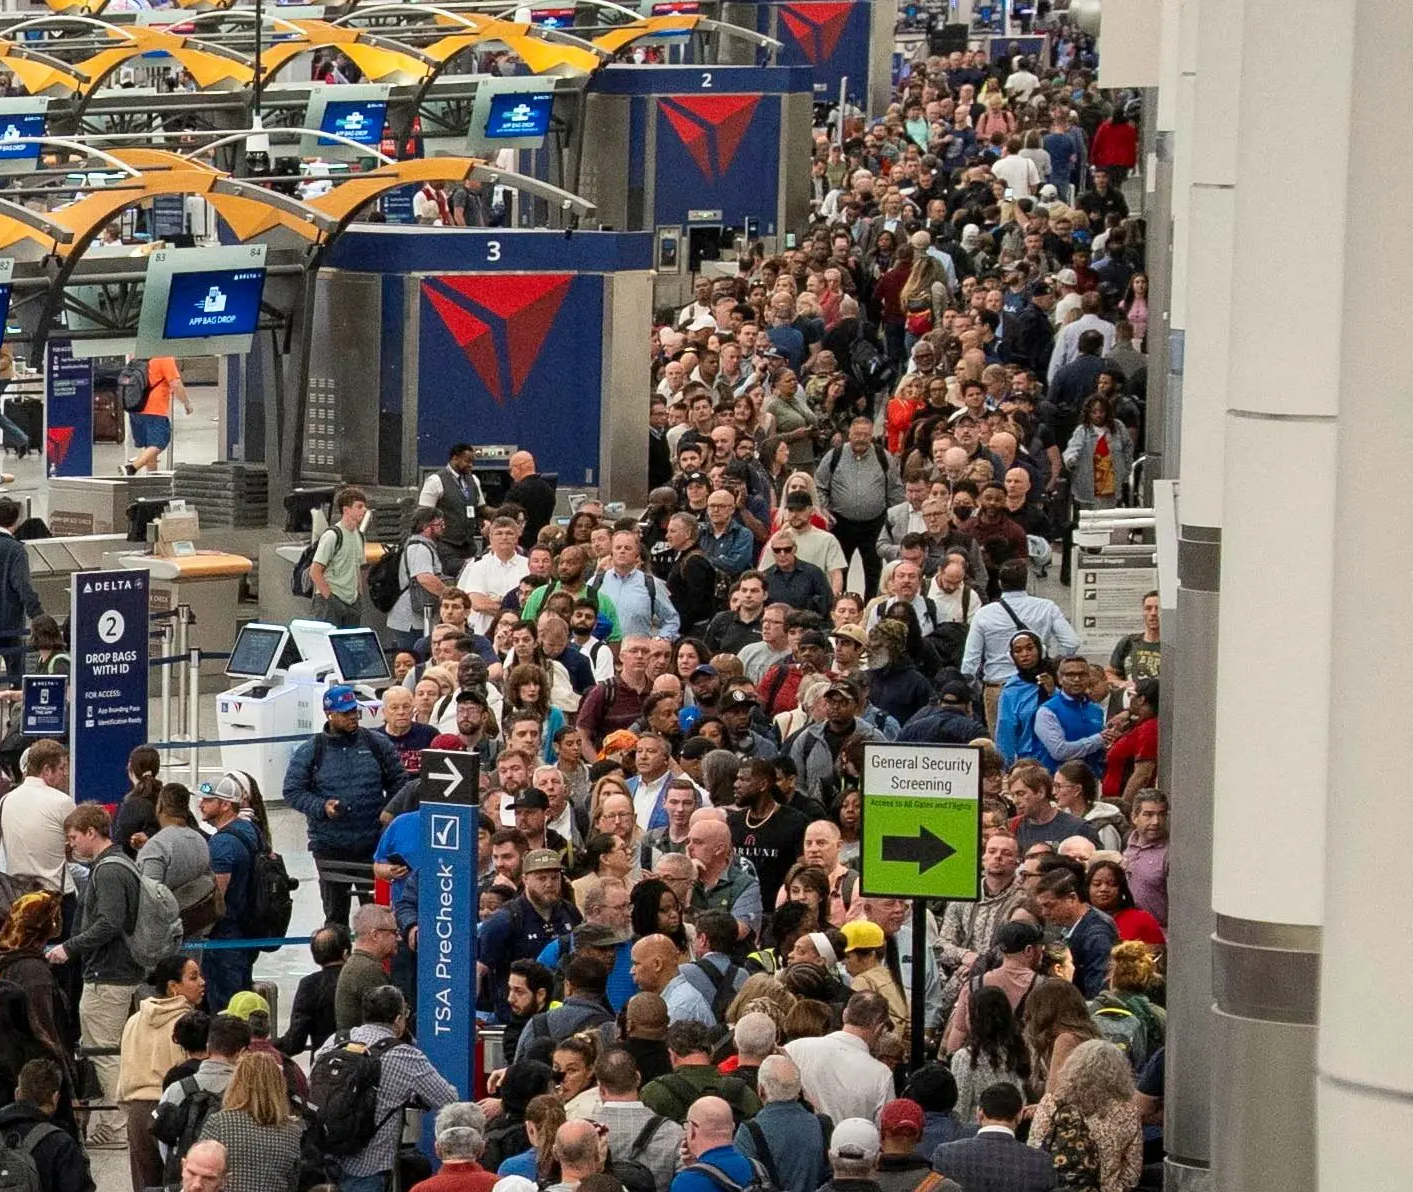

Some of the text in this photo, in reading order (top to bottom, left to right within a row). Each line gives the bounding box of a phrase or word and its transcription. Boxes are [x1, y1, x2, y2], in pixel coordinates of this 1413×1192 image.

[701, 73, 712, 87] 2
[155, 252, 166, 262] 83
[250, 248, 261, 257] 84
[486, 241, 501, 261] 3
[189, 315, 236, 325] APP BAG DROP
[95, 580, 132, 592] DELTA
[106, 617, 116, 637] 2
[86, 651, 137, 664] DROP BAGS
[93, 665, 129, 676] WITH ID
[98, 690, 122, 698] ACCESS:
[872, 755, 972, 774] General Security
[891, 776, 952, 794] Screening
[870, 798, 893, 807] Access
[949, 801, 972, 811] Flights
[435, 988, 452, 1036] TSA
